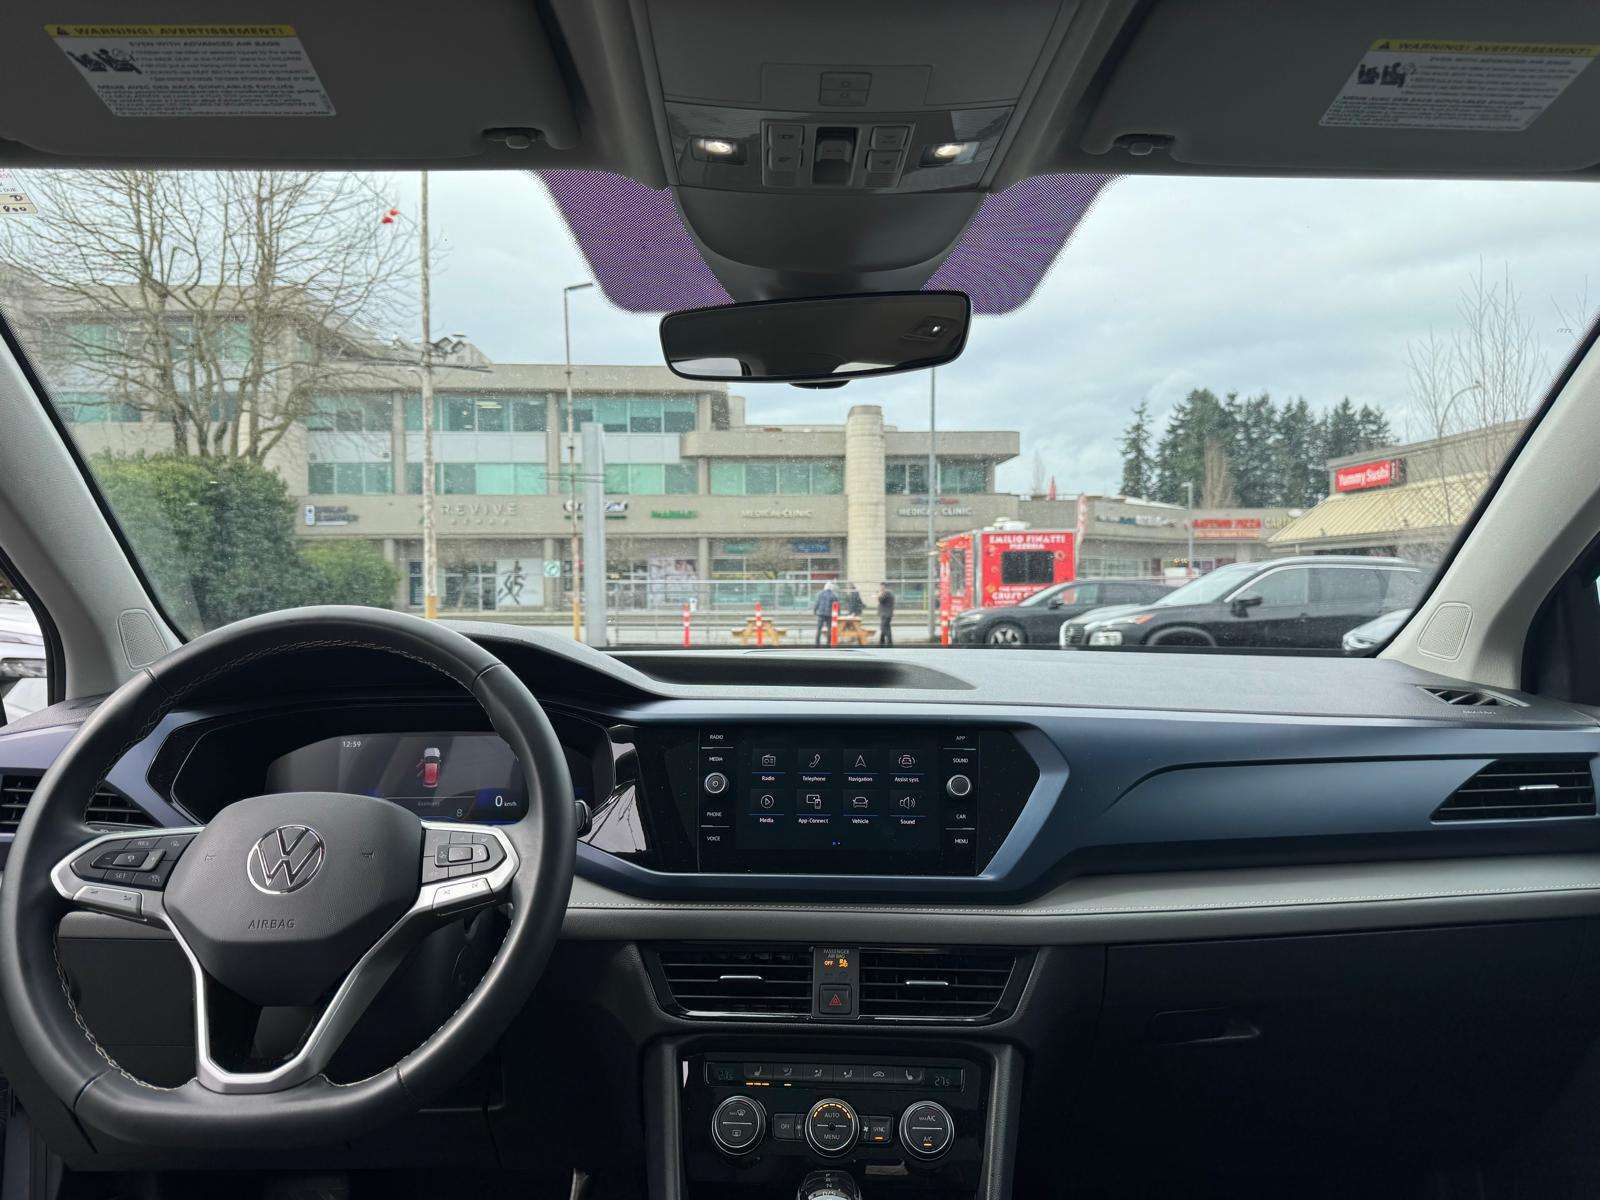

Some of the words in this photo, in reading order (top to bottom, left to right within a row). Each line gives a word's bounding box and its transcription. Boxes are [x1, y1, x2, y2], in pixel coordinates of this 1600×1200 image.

[74, 26, 153, 36] WARNING!
[440, 503, 518, 516] REVIVE
[897, 506, 939, 517] MEDIC
[943, 506, 974, 517] CLINIC
[989, 534, 1024, 544] EMILIO
[343, 740, 362, 748] 12:59
[802, 775, 826, 783] Telephone
[495, 795, 503, 807] 0
[248, 919, 296, 930] AIRBAG
